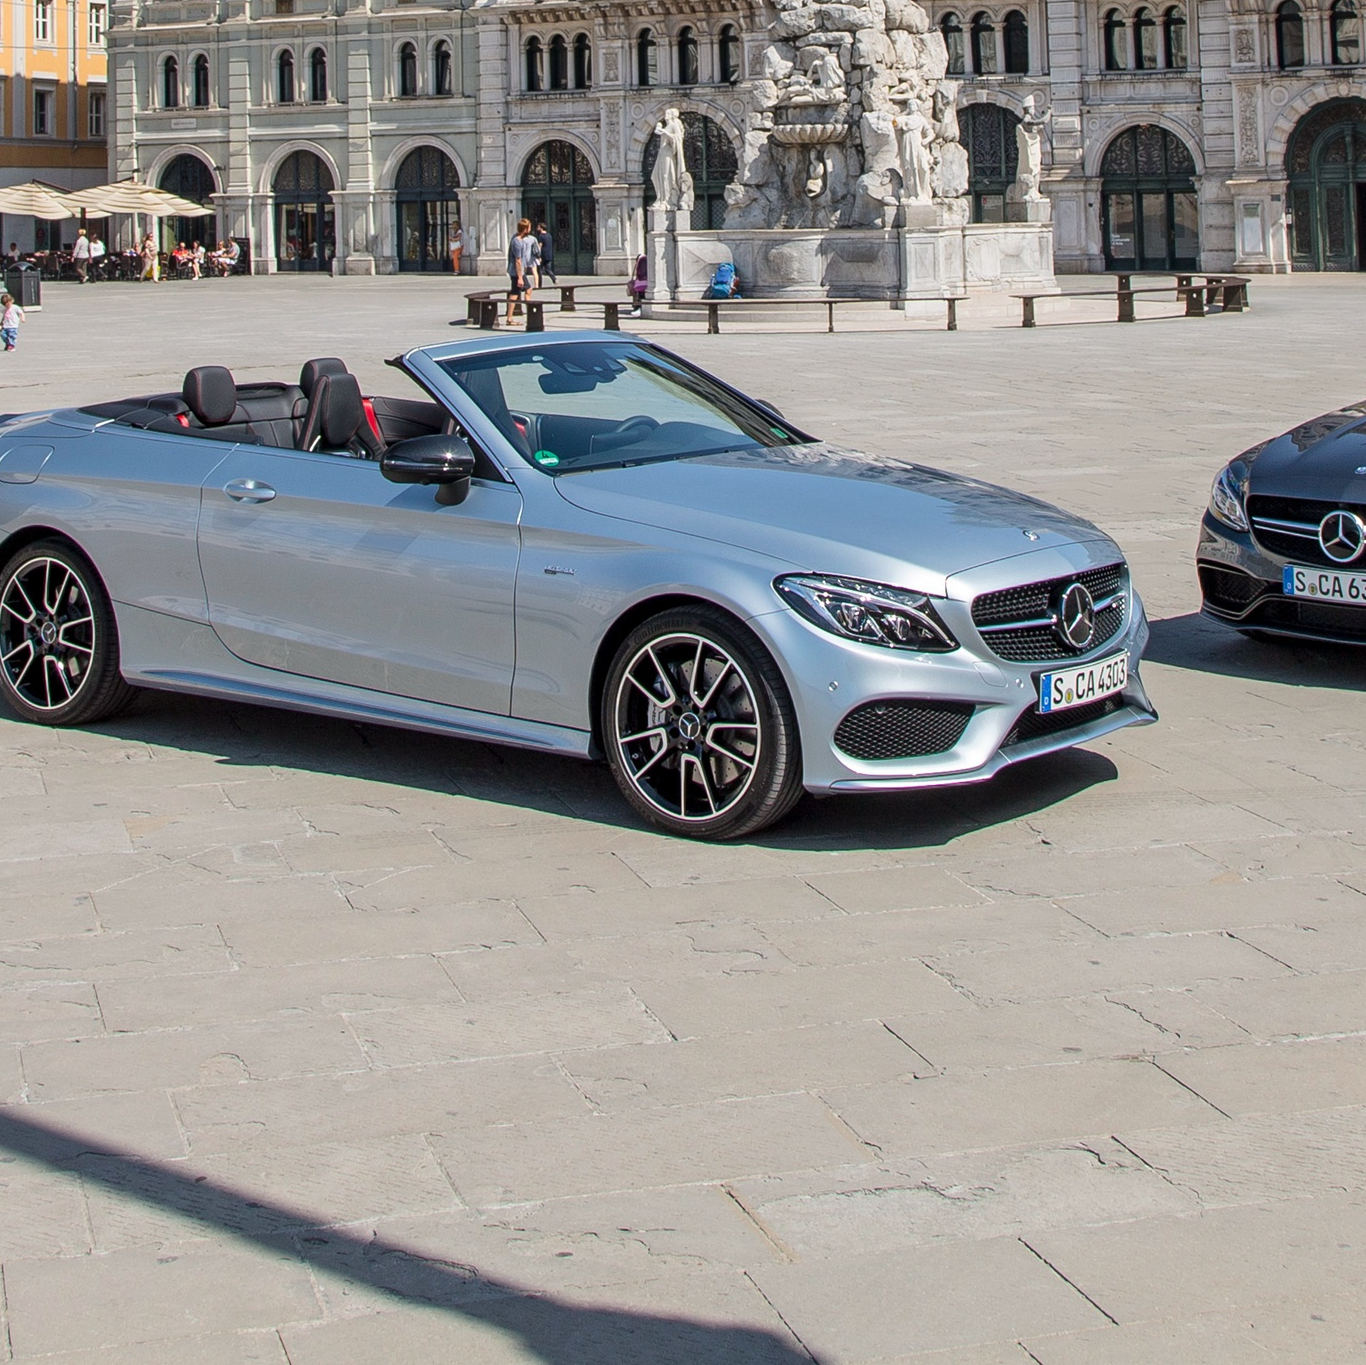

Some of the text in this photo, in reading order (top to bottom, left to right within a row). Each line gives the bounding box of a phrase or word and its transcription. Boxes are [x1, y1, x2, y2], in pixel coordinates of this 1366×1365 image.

[1295, 571, 1306, 592] S
[1318, 574, 1344, 598] CA
[1053, 658, 1126, 704] S CA 4303
